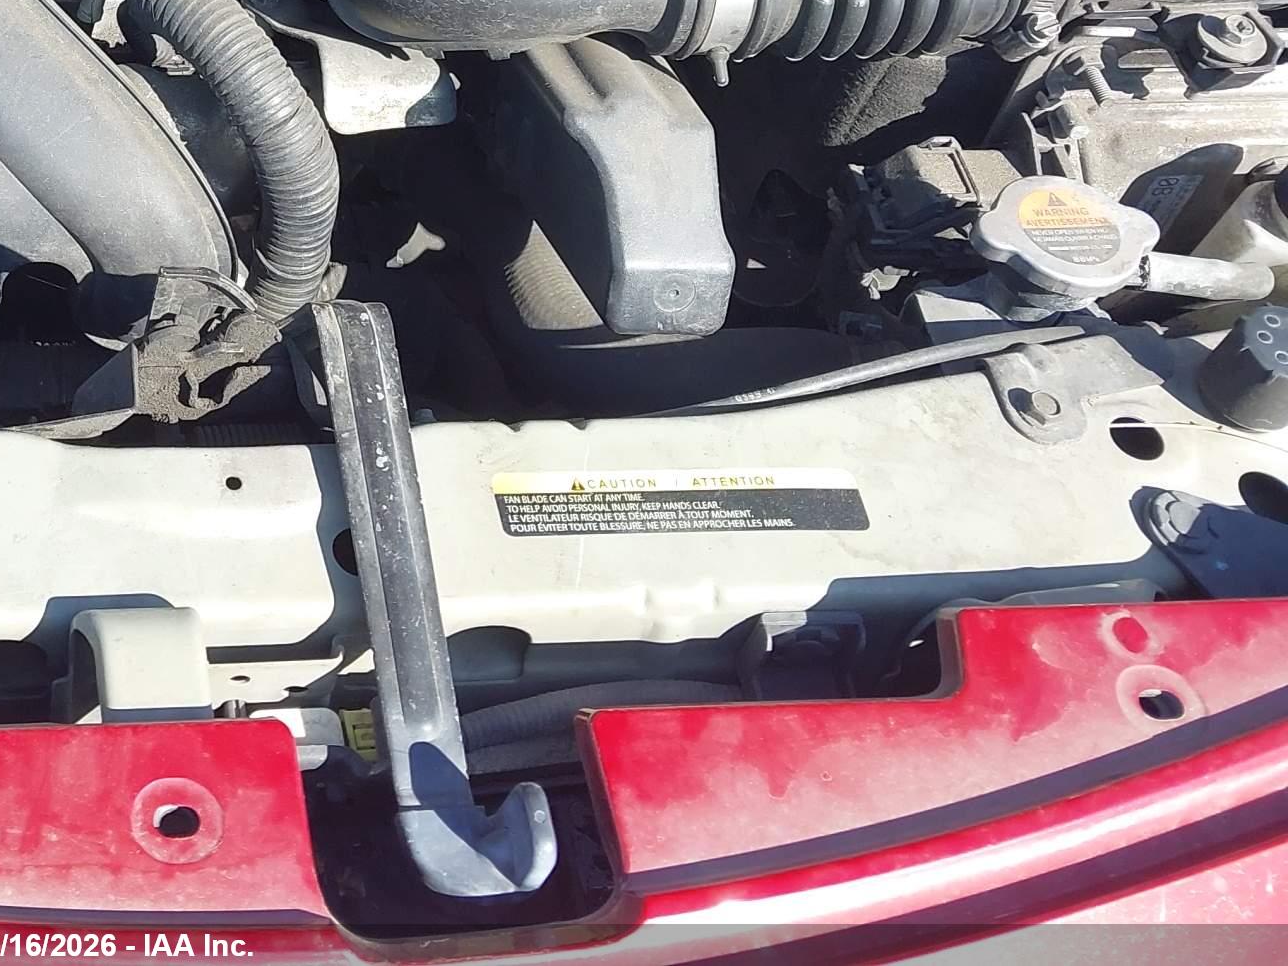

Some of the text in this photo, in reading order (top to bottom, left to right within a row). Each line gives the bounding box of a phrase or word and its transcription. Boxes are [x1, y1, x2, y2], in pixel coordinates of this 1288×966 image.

[1032, 207, 1089, 217] WARNING
[587, 479, 657, 489] CAUTION
[692, 476, 775, 487] ATTENTION
[504, 496, 522, 504] FAN
[522, 495, 549, 503] BLADE
[550, 495, 568, 503] CAN
[569, 494, 593, 503] START
[593, 493, 605, 502] AT
[606, 493, 622, 502] ANY
[507, 505, 519, 513] TO
[520, 505, 540, 513] HELP
[542, 504, 568, 513] AVOID
[568, 503, 611, 512] PERSONAL
[612, 503, 641, 512] INJURY,
[642, 502, 661, 511] KEEP
[662, 502, 692, 510] HANDS
[509, 514, 520, 523] LE
[520, 513, 580, 523] VENTILATEUR
[581, 513, 613, 522] RISQUE
[613, 512, 628, 521] DE
[629, 509, 677, 520] DÉMARRER
[686, 511, 710, 519] TOUT
[711, 510, 755, 519] MOMENT.
[512, 523, 538, 532] POUR
[539, 522, 569, 532] ÉVITER
[569, 523, 600, 532] TOUTE
[647, 522, 660, 530] NE
[660, 521, 678, 530] PAS
[678, 521, 691, 529] EN
[692, 520, 747, 529] APPROCHER
[747, 519, 763, 528] LES
